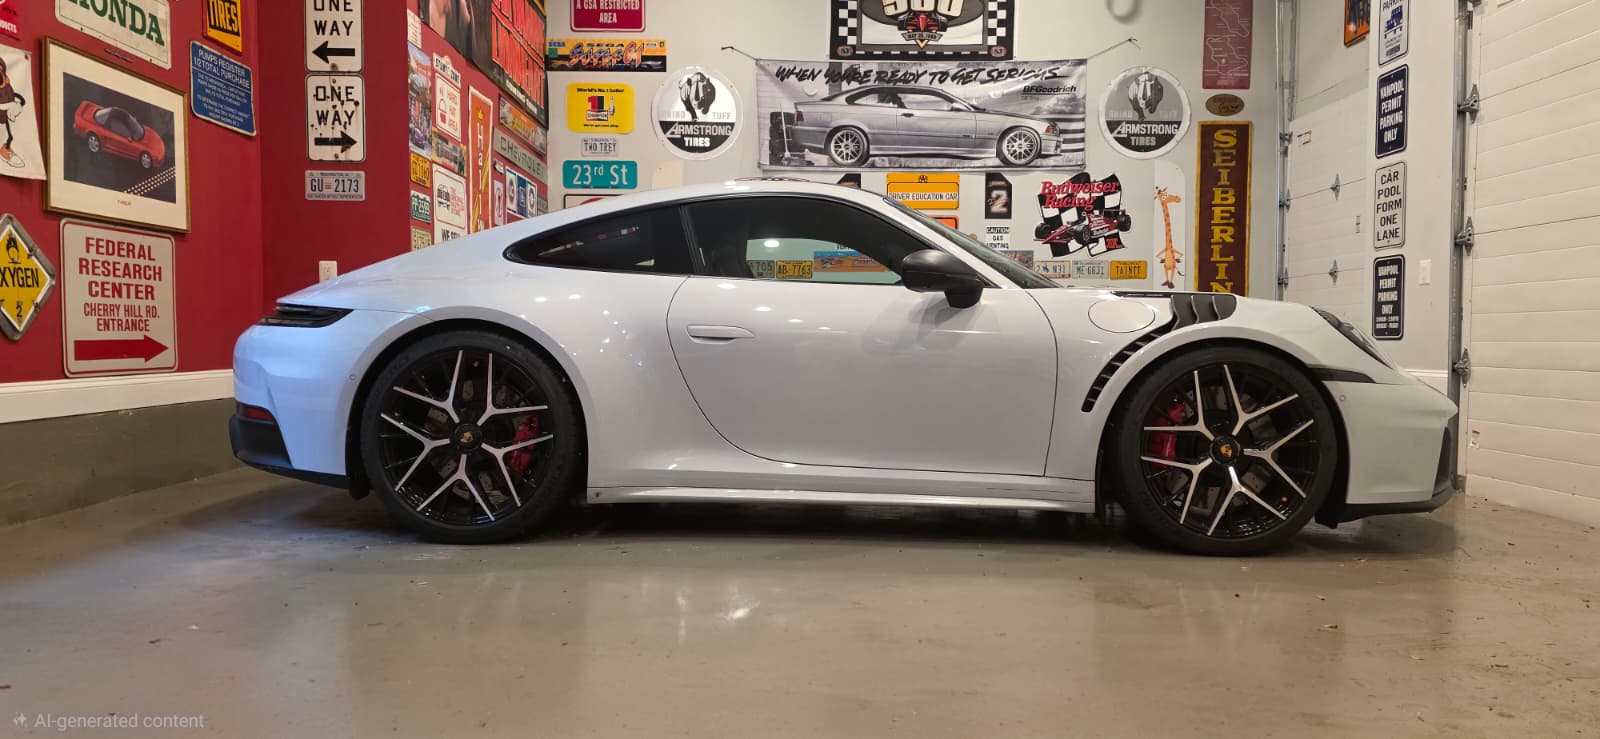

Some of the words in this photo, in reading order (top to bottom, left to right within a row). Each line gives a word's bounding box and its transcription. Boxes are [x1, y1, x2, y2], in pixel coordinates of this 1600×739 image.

[314, 0, 353, 12] ONE
[583, 0, 597, 9] GSA
[600, 0, 640, 10] RESTRICTED
[66, 0, 165, 46] ONDA
[208, 0, 239, 32] TIRES
[599, 12, 617, 23] AREA
[314, 20, 353, 36] WAY
[198, 49, 218, 65] PUMPS
[218, 58, 246, 77] REGISTER
[202, 60, 220, 76] TOTAL
[221, 69, 250, 88] PURCHASE
[775, 65, 822, 82] WHEN
[874, 69, 927, 85] READY
[928, 70, 949, 85] TO
[951, 67, 986, 85] GET
[980, 67, 1071, 84] SERIOUS
[315, 86, 355, 101] ONE
[1022, 85, 1077, 93] BFGoodrich
[1381, 95, 1402, 114] PERMIT
[316, 110, 354, 126] WAY
[1380, 110, 1403, 130] PARKING
[665, 121, 732, 137] ARMSTRONG
[1111, 121, 1178, 137] ARMSTRONG
[1383, 128, 1398, 143] ONLY
[584, 142, 597, 151] TWO
[600, 142, 617, 152] TREY
[683, 137, 711, 147] TIRES
[1130, 136, 1156, 146] TIRES
[572, 164, 604, 185] 23rd
[610, 164, 628, 185] St
[1380, 171, 1400, 185] CAR
[311, 178, 324, 192] GU
[334, 178, 359, 193] 2173
[1040, 180, 1120, 196] Budweiser
[1377, 184, 1402, 200] POOL
[889, 192, 910, 200] DRIVER
[912, 192, 943, 200] EDUCATION
[945, 192, 958, 200] CAR
[1044, 194, 1097, 211] Racing
[1376, 198, 1402, 214] FORM
[1379, 213, 1398, 227] ONE
[1376, 227, 1400, 242] LANE
[85, 236, 156, 261] FEDERAL
[0, 267, 39, 288] XYGEN
[78, 257, 162, 282] RESEARCH
[88, 280, 155, 300] CENTER
[16, 304, 23, 318] 2
[83, 302, 120, 318] CHERRY
[124, 303, 144, 318] HILL
[146, 305, 160, 319] RD.
[96, 318, 150, 332] ENTRANCE
